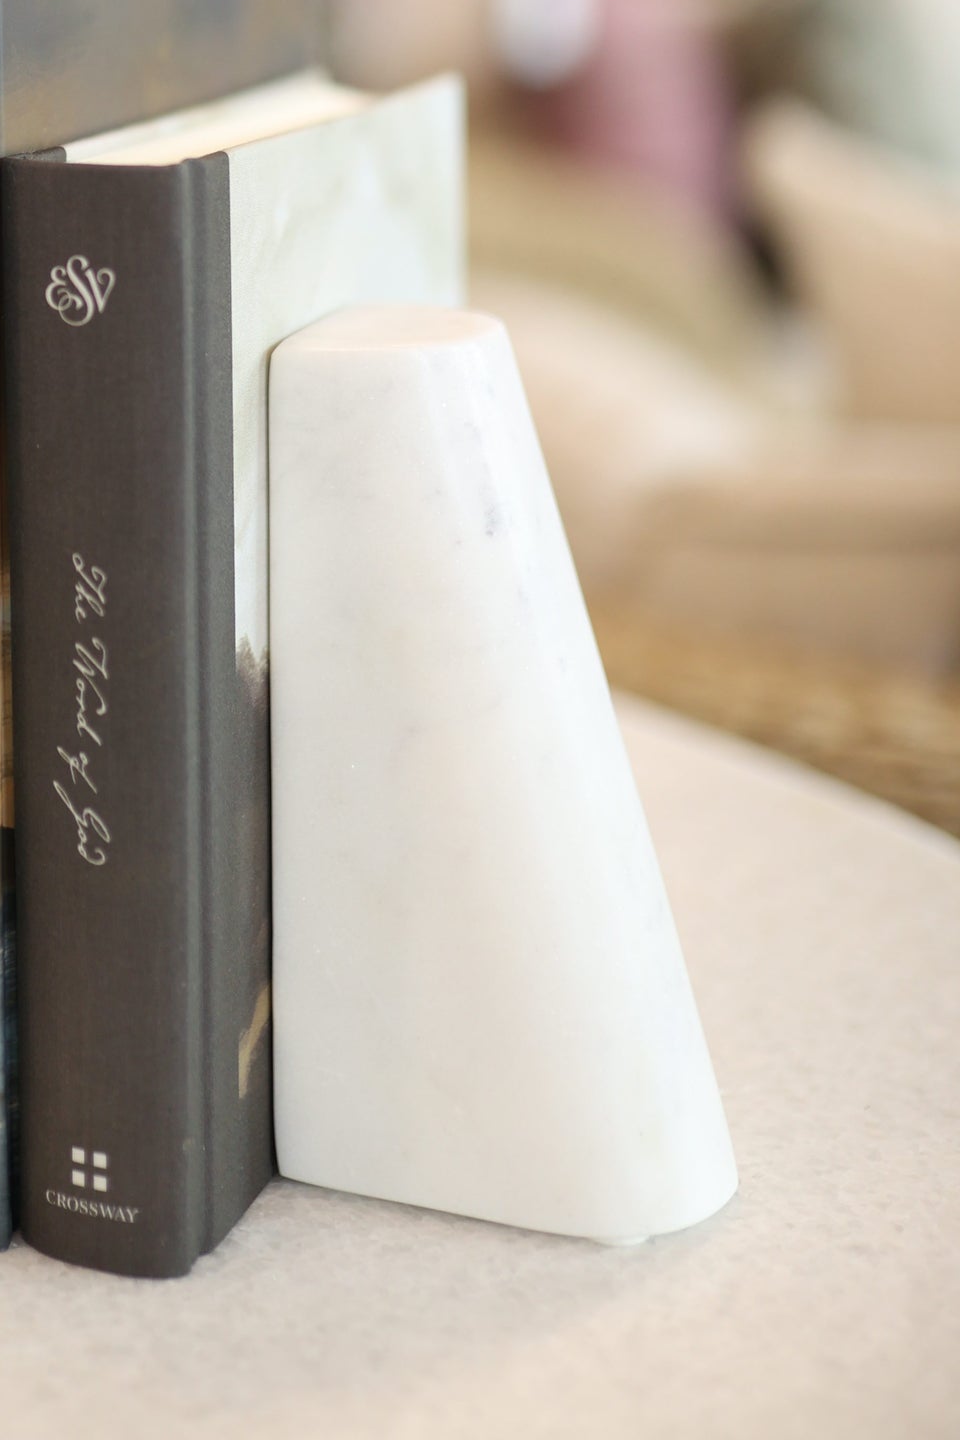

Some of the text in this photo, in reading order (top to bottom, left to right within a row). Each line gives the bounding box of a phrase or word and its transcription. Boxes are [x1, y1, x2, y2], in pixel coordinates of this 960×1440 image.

[45, 255, 116, 327] ESV
[53, 552, 111, 866] The Word of God
[45, 1189, 140, 1224] CROSSWAY
